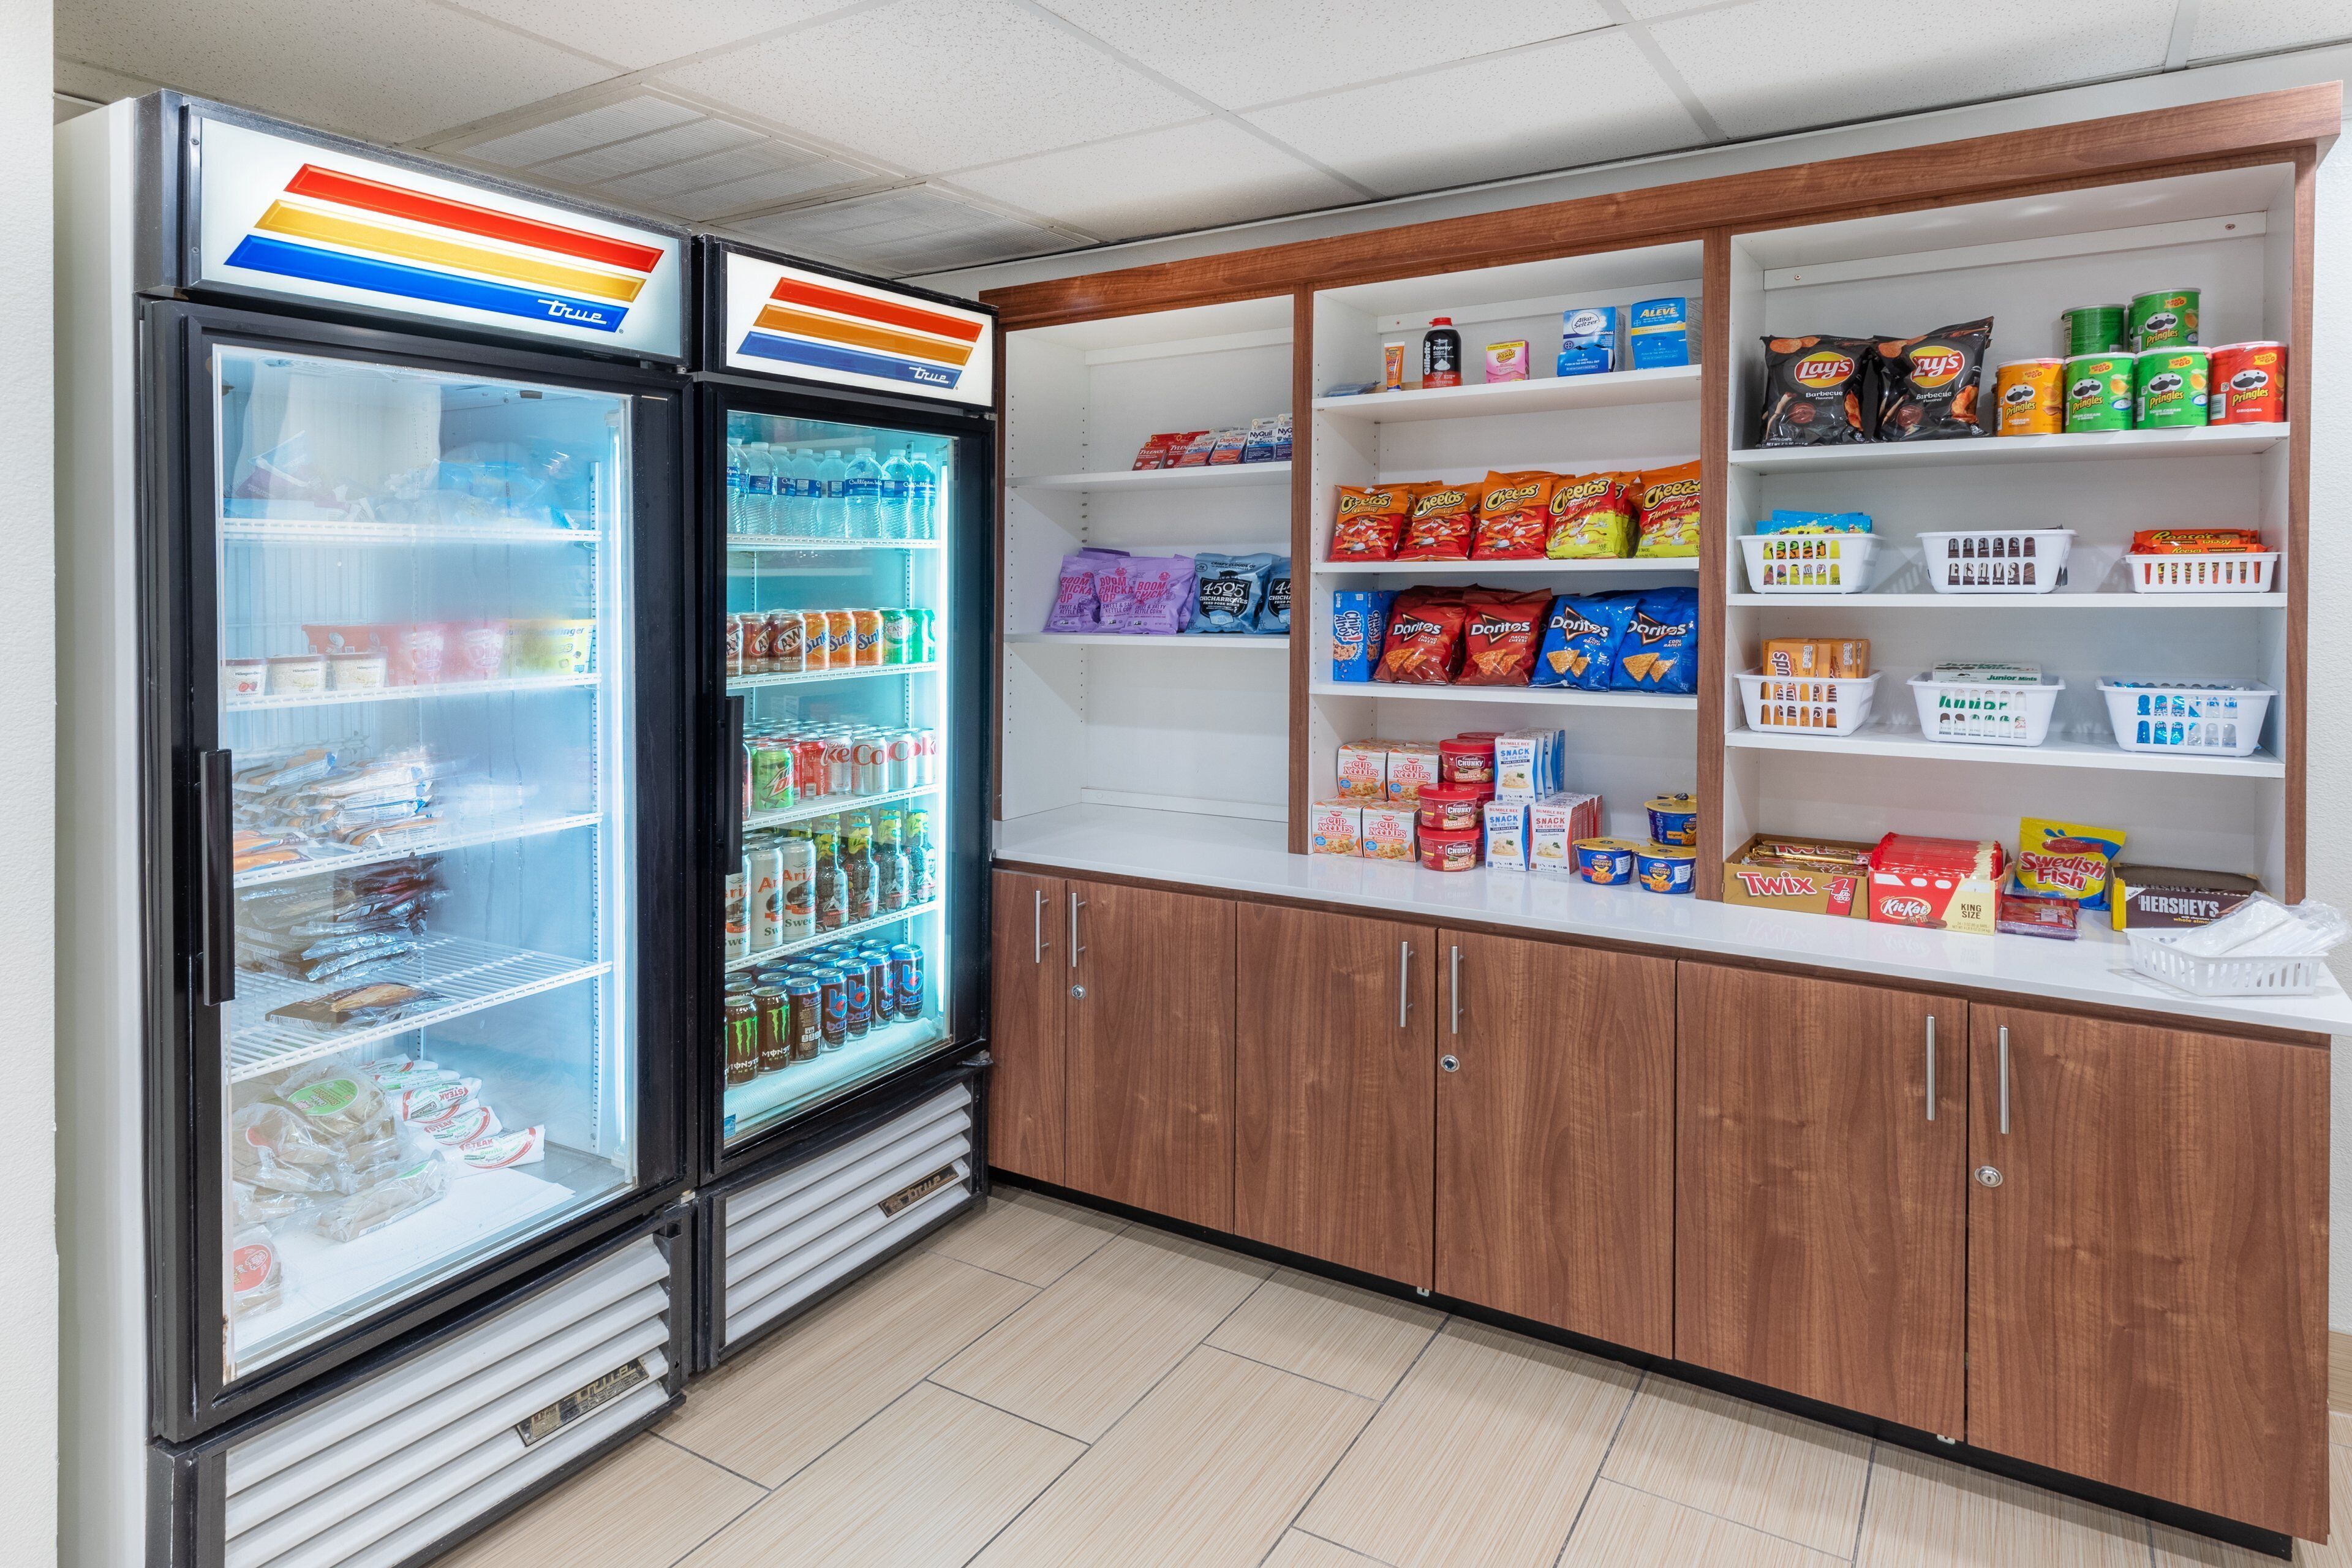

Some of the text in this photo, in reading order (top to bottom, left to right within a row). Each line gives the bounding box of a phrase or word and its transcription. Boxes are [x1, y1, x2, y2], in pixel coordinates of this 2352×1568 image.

[538, 299, 607, 325] true
[1640, 307, 1676, 318] ALEVE
[1574, 320, 1597, 328] Seltzer
[2146, 330, 2178, 347] Pringles
[1800, 359, 1852, 379] Lay's
[1913, 353, 1960, 377] Lay's
[909, 366, 949, 383] true
[1916, 391, 1952, 399] Barbecue
[2149, 391, 2184, 409] Pringles
[2232, 388, 2269, 405] Pringles
[2006, 402, 2036, 419] Pringles
[2073, 396, 2103, 413] Pringles
[1341, 495, 1392, 513] Cheetos
[1413, 491, 1466, 517] Cheetos
[1485, 484, 1540, 510] Cheetos
[1551, 480, 1610, 514] Cheetos
[1583, 499, 1600, 509] Hot
[1061, 577, 1090, 586] BOOM
[1099, 576, 1126, 586] BOOM
[1137, 582, 1166, 590] BOOM
[1203, 582, 1245, 597] 4505
[1200, 596, 1248, 605] CHICHARRONES
[1393, 621, 1442, 636] Doritos
[1471, 622, 1530, 636] Doritos
[1550, 616, 1609, 638] Doritos
[1627, 620, 1686, 636] Doritos
[1500, 748, 1529, 756] SNACK
[1344, 767, 1379, 777] NOODLES
[1393, 771, 1430, 780] NOODLES
[1318, 823, 1354, 833] NOODLES
[1370, 828, 1406, 838] NOODLES
[2020, 852, 2105, 880] Swedish
[1739, 872, 1848, 895] Twix 4
[2037, 867, 2086, 891] Fish
[1961, 903, 1981, 912] KING
[2141, 895, 2219, 917] HERSHEY'S
[1962, 911, 1981, 919] SIZE
[762, 1045, 791, 1057] MONST
[439, 1087, 464, 1101] STEAK
[429, 1119, 454, 1133] STEAK
[464, 1139, 494, 1149] STEAK
